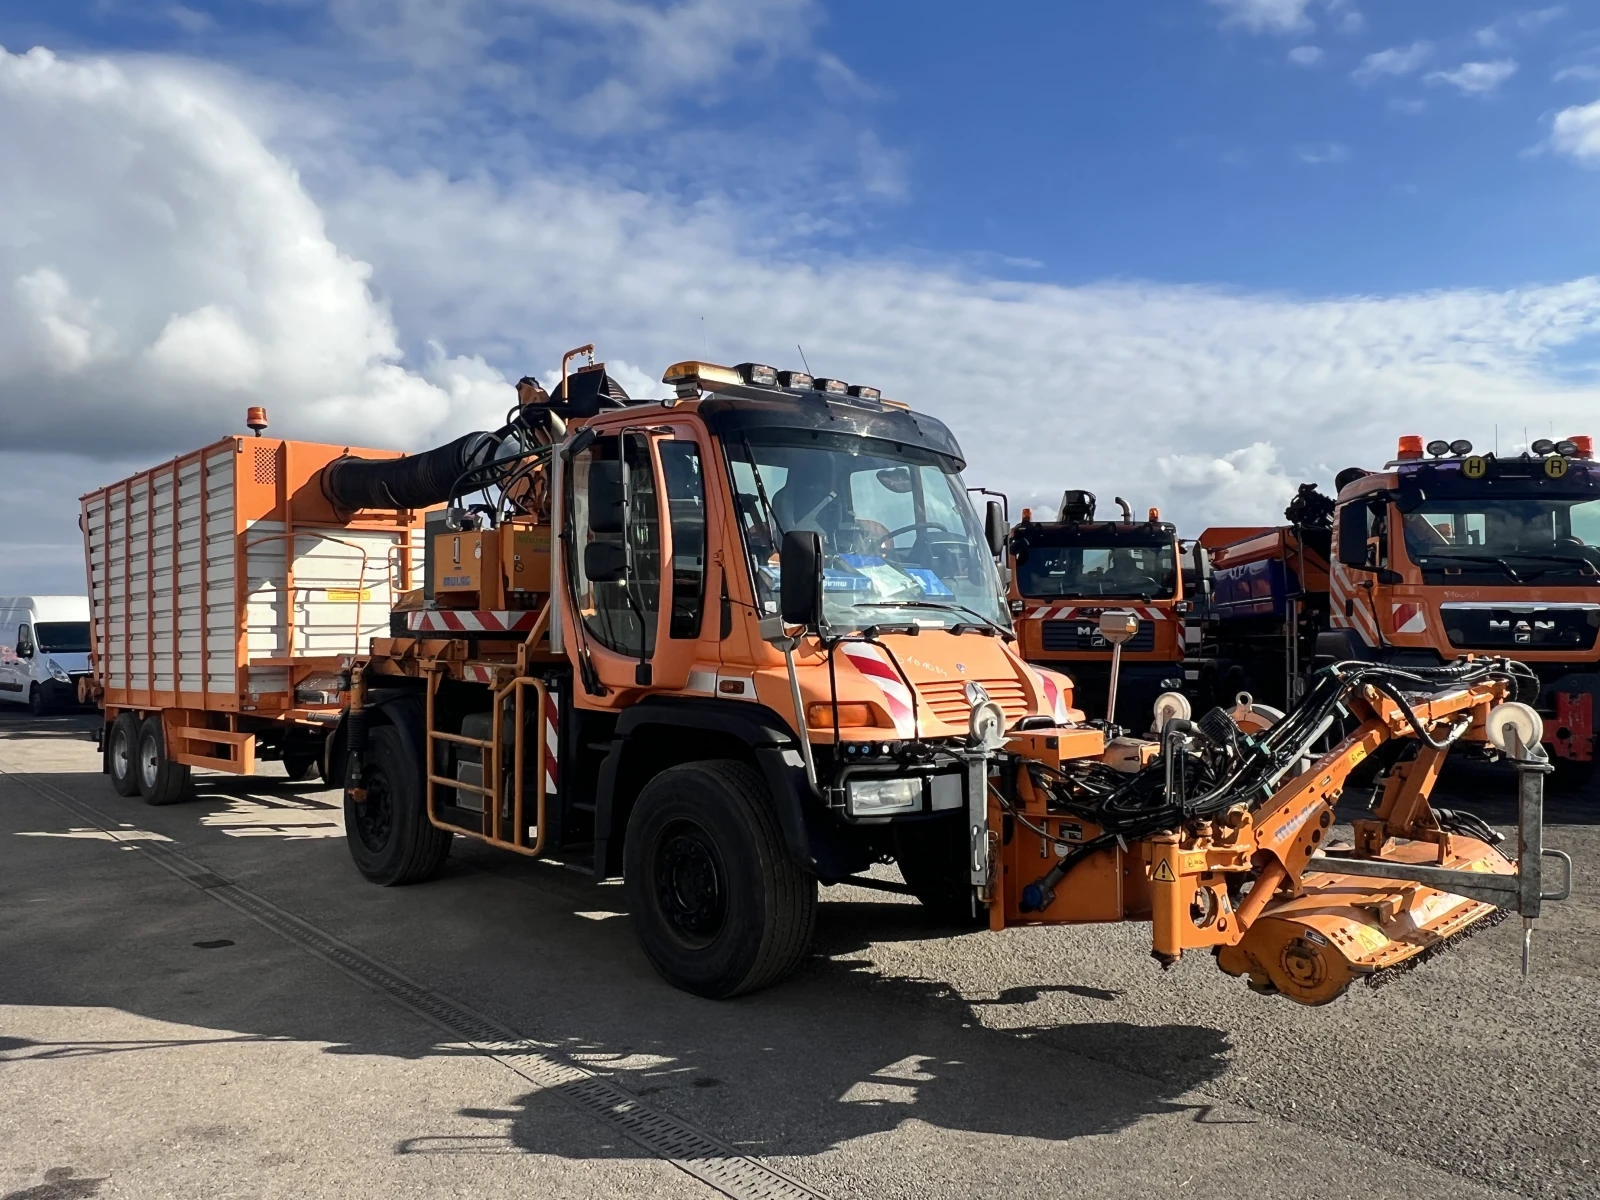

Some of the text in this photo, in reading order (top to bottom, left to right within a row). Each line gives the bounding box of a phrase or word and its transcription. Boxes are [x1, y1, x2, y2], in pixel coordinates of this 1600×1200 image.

[1468, 460, 1481, 474] H
[1550, 460, 1562, 474] R
[1077, 626, 1102, 636] MA
[1489, 620, 1556, 632] MAN
[1029, 737, 1036, 750] 1
